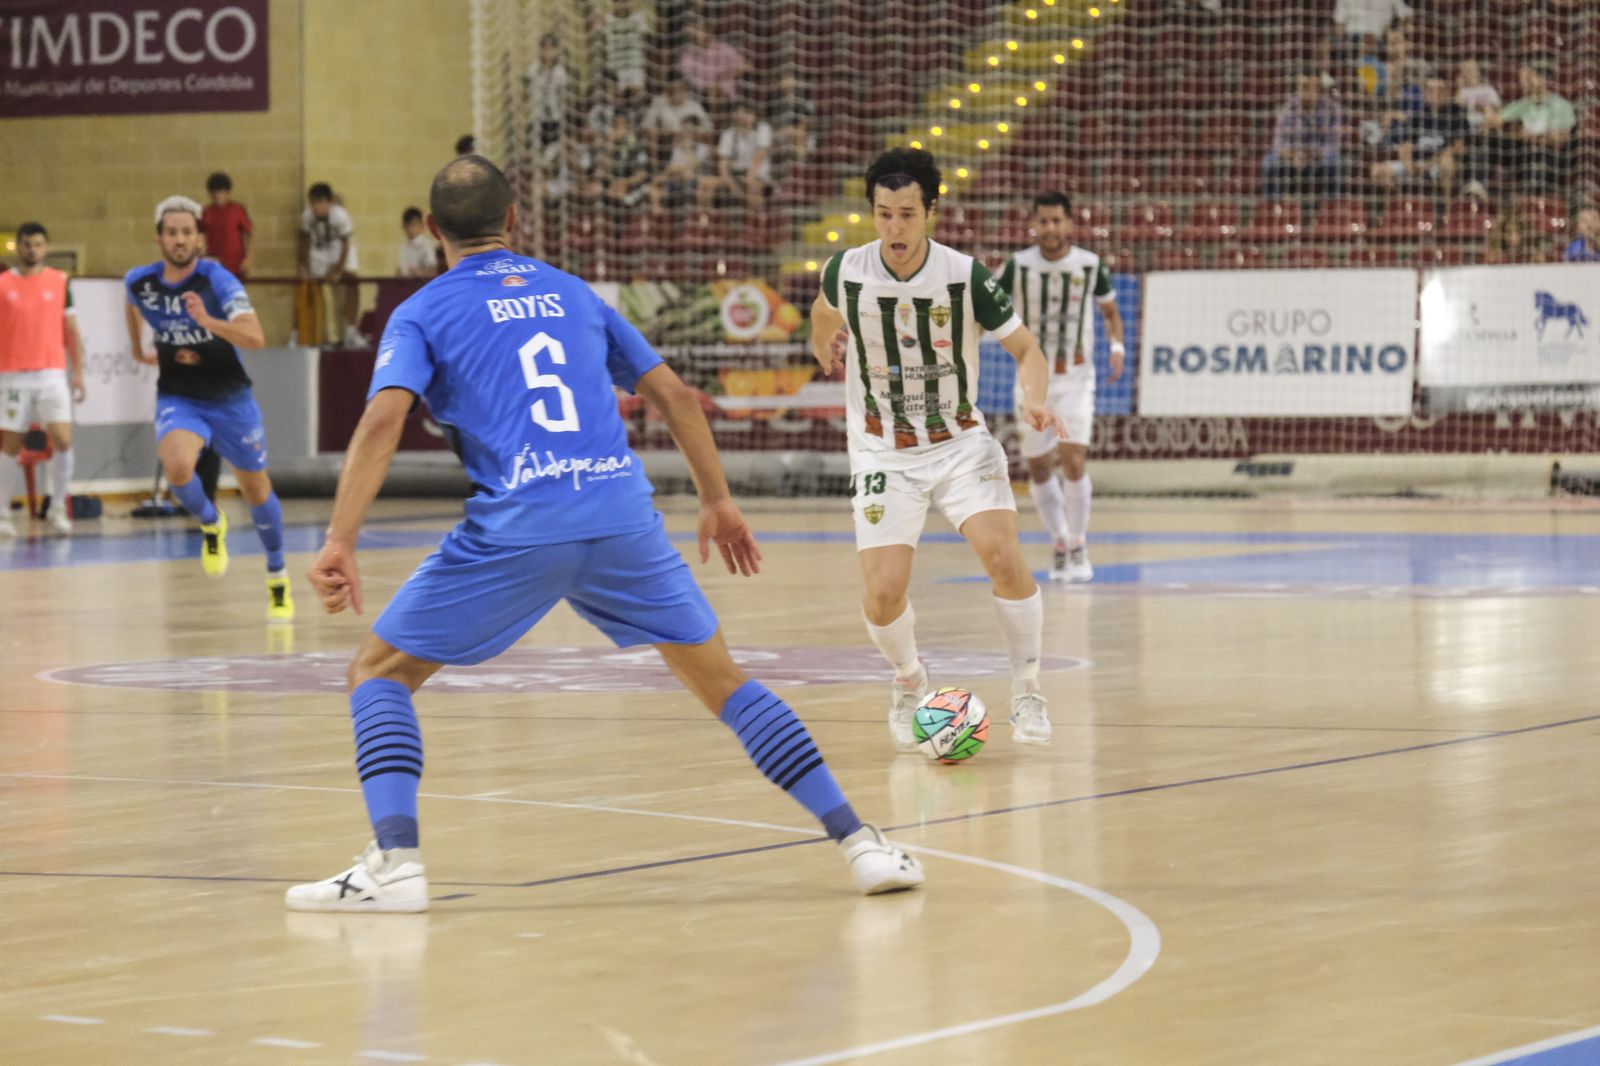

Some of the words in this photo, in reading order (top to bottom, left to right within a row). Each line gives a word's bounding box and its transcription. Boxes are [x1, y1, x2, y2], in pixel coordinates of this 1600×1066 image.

[10, 7, 257, 69] IMDECO
[108, 75, 182, 96] Deportes
[164, 295, 182, 315] 14
[1227, 308, 1333, 337] GRUPO
[1152, 343, 1408, 375] ROSMARINO
[518, 332, 580, 432] 5
[864, 471, 887, 496] 13
